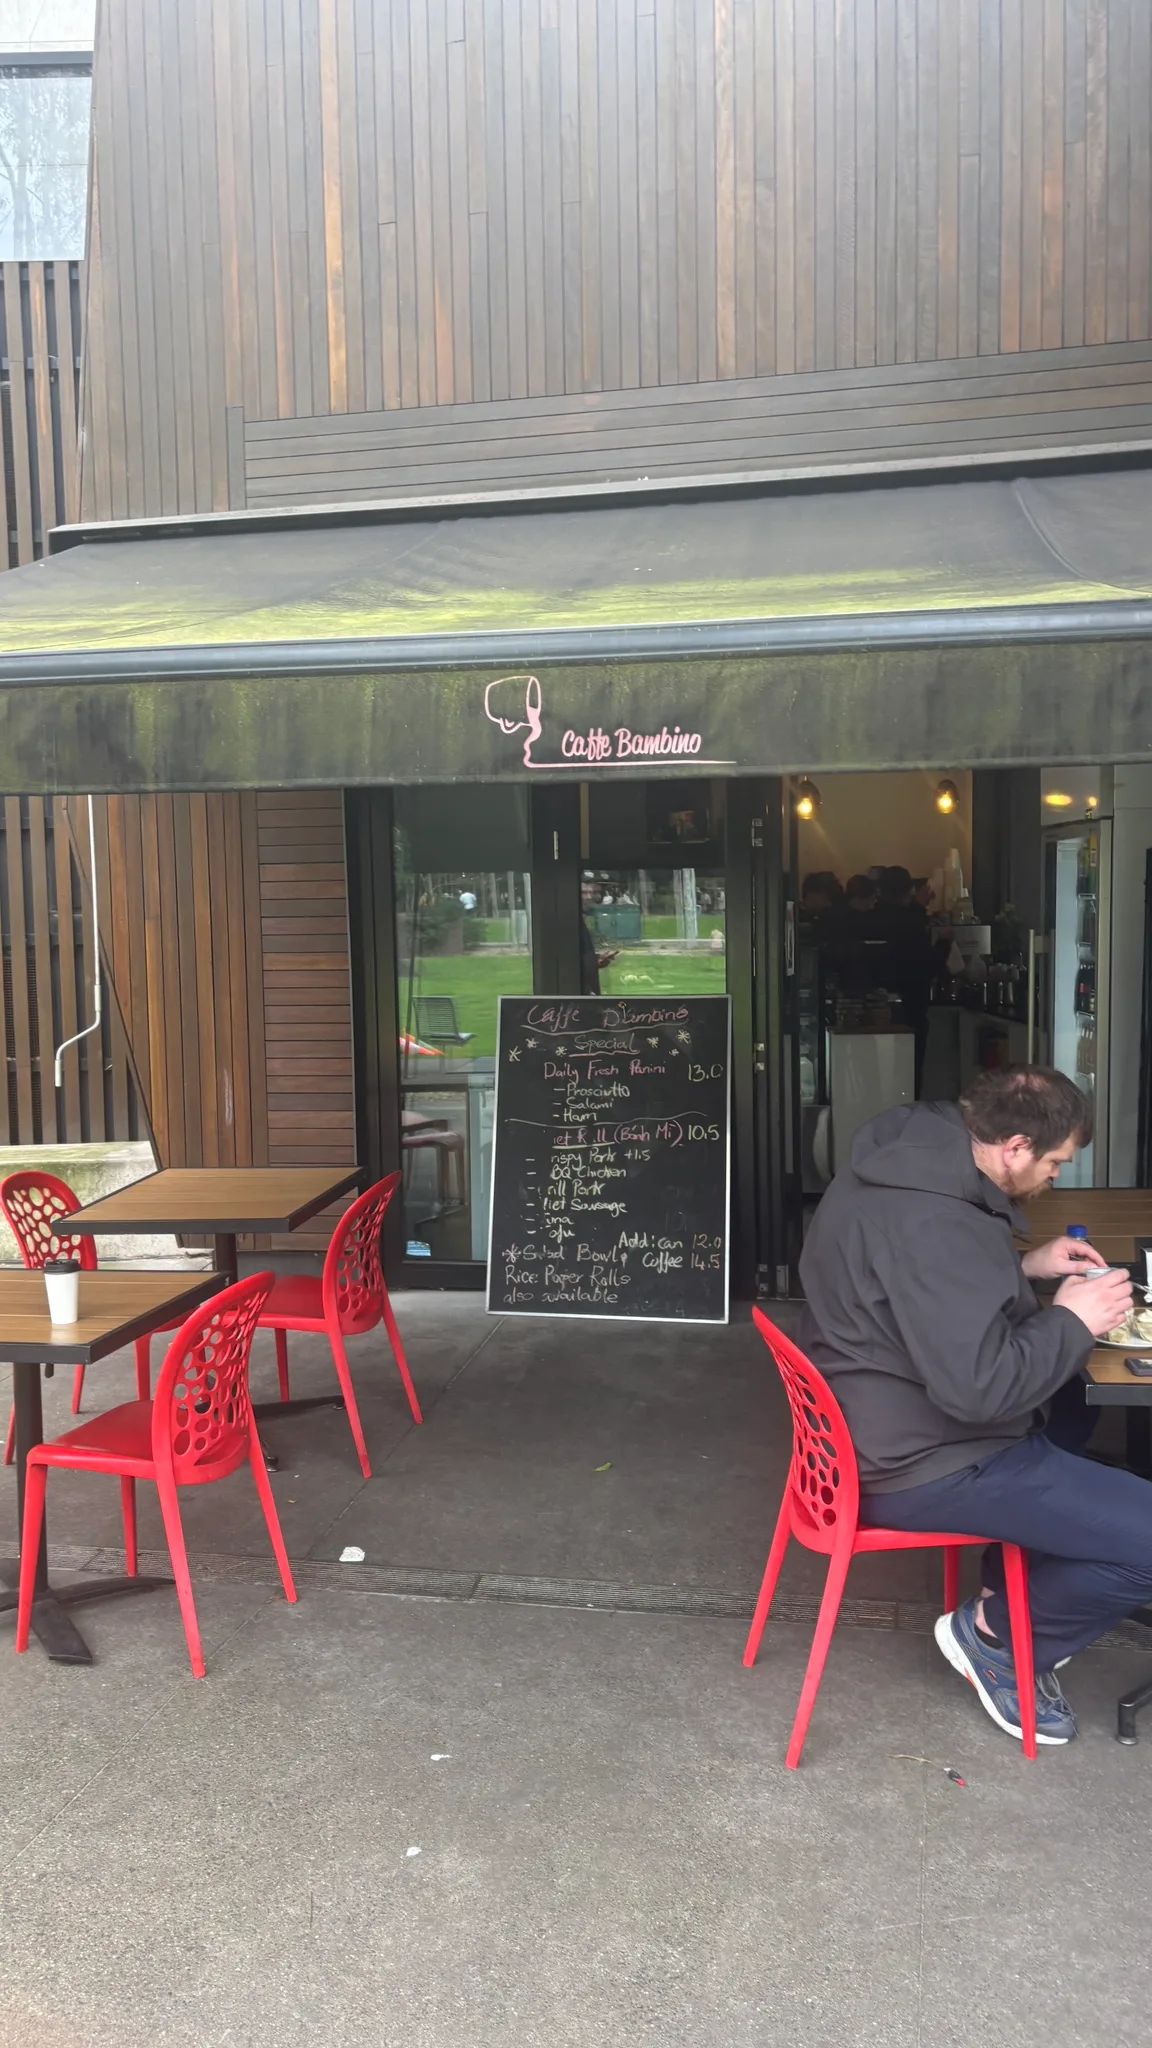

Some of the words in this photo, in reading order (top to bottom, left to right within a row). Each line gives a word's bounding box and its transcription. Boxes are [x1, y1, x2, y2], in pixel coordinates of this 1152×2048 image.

[561, 727, 612, 761] Caffe
[614, 726, 702, 758] Bambino
[526, 1002, 581, 1033] Caffe
[573, 1032, 641, 1054] Special
[543, 1062, 580, 1084] Daily
[587, 1059, 620, 1081] Fresh
[629, 1058, 667, 1077] Panini
[687, 1062, 724, 1083] 13.0
[566, 1097, 614, 1110] Salami
[563, 1107, 598, 1123] Ham
[687, 1124, 721, 1142] 10.5
[589, 1146, 617, 1163] Pork
[572, 1178, 606, 1198] Pork
[570, 1198, 628, 1218] Sausage
[692, 1233, 723, 1249] 12.0
[641, 1250, 684, 1275] Coffee
[690, 1252, 721, 1271] 14.5
[544, 1263, 585, 1292] Paper
[589, 1264, 632, 1288] Rolls
[503, 1286, 535, 1305] also
[541, 1285, 619, 1304] available
